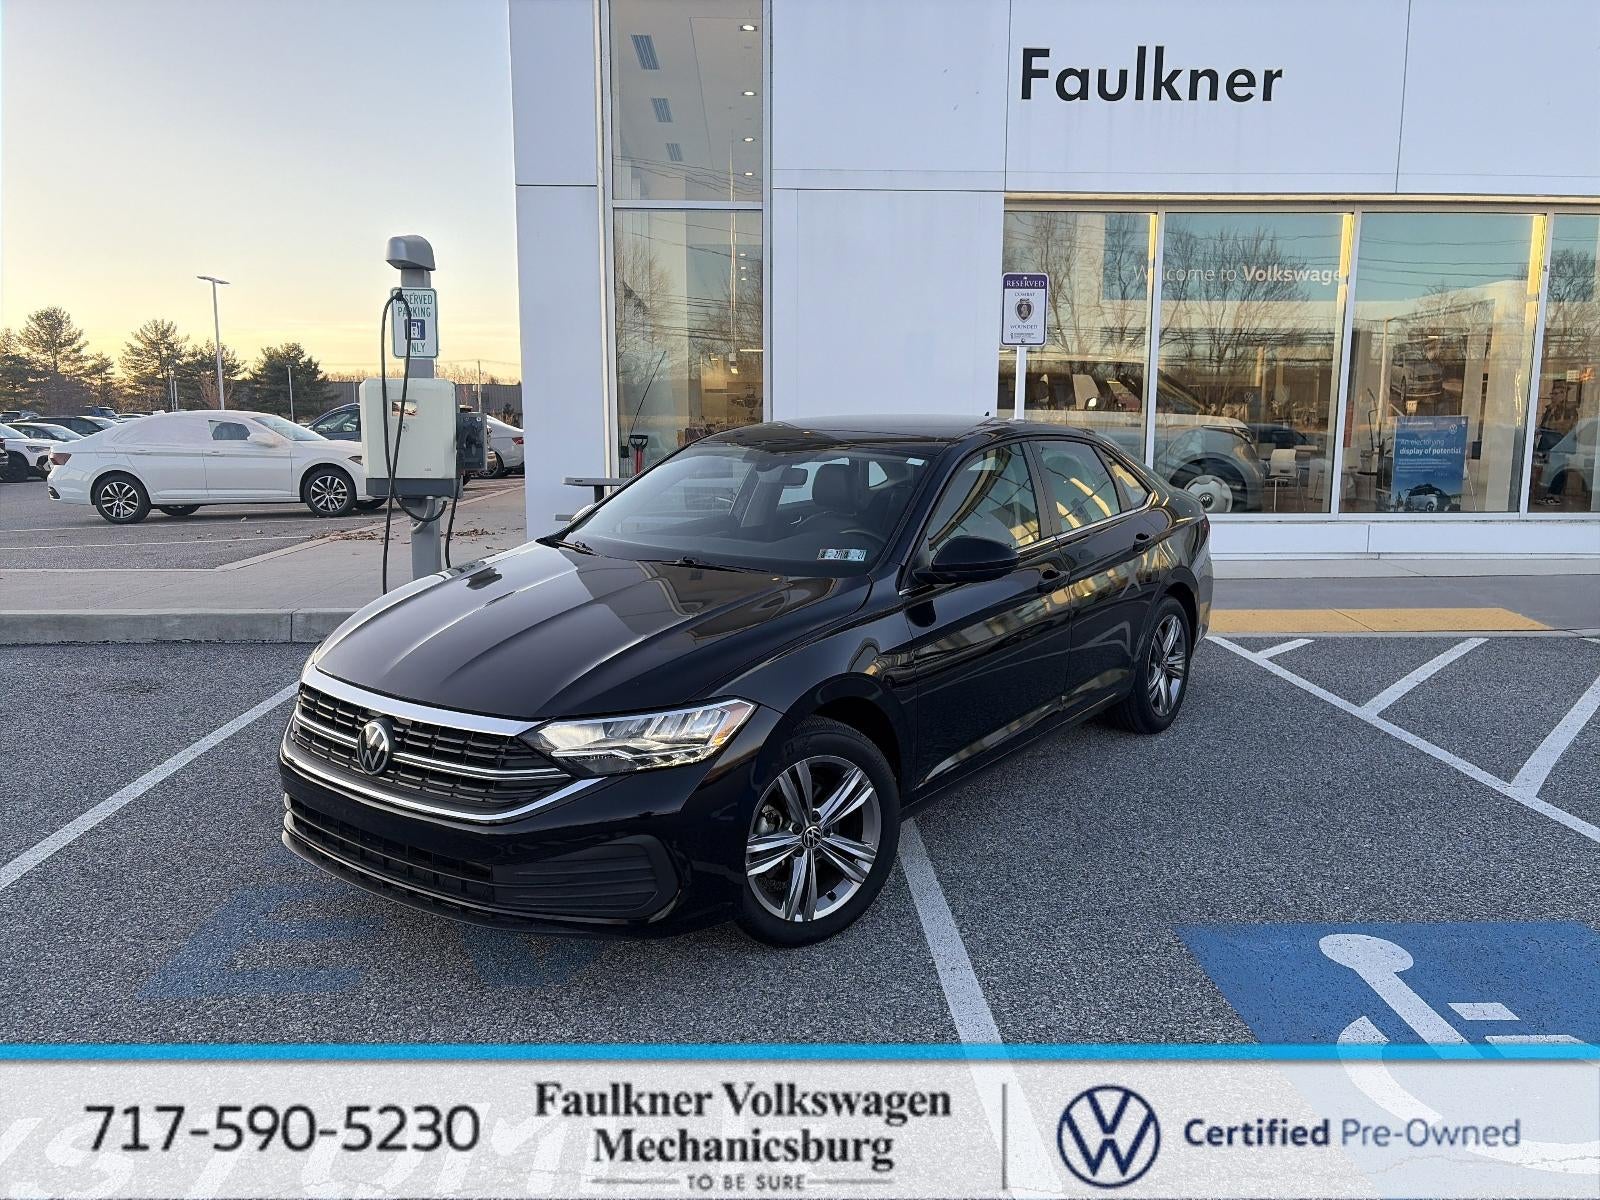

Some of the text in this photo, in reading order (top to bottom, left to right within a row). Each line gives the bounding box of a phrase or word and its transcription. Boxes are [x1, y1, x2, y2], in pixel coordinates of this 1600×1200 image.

[1021, 45, 1283, 102] Faulkner
[1133, 264, 1215, 282] Wlcome
[1221, 266, 1237, 282] to
[1006, 279, 1045, 288] RESERVED
[1400, 447, 1424, 456] display
[1425, 447, 1431, 455] of
